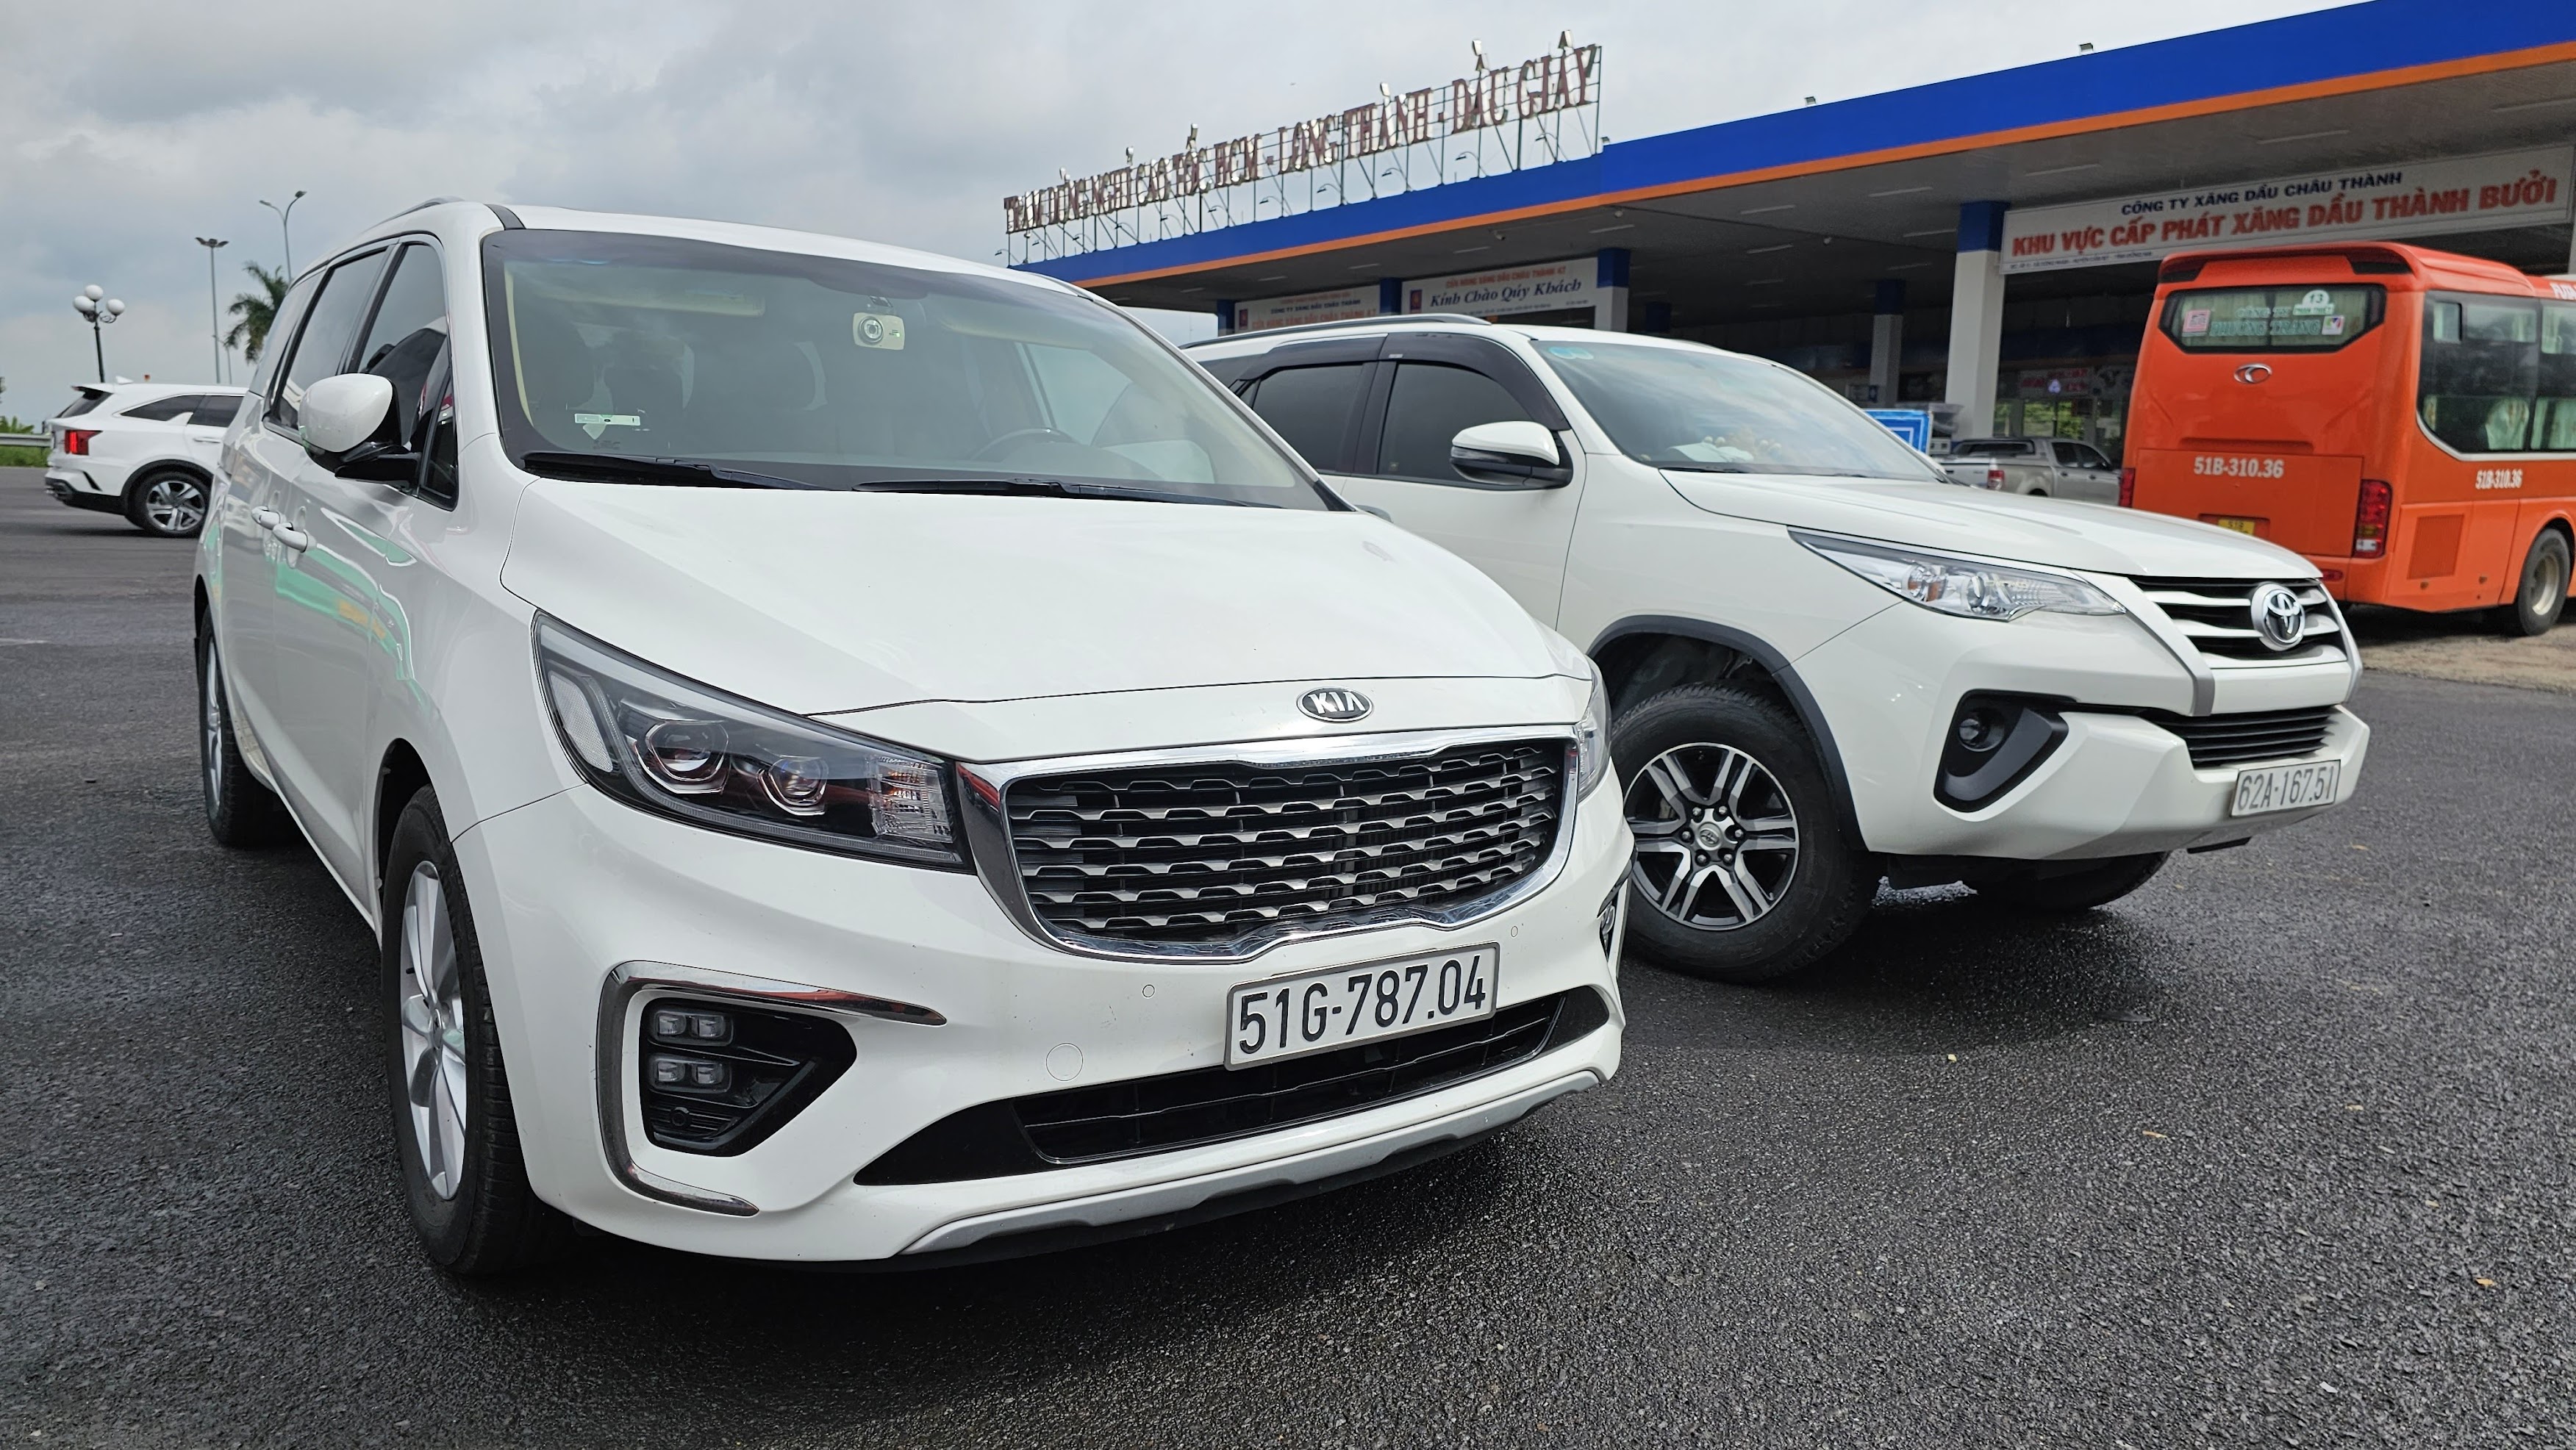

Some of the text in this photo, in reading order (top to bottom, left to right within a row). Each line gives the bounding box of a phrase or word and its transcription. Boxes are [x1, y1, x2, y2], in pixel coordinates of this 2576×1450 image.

[1214, 134, 1264, 189] HCM
[1278, 113, 1339, 175] LONG
[1342, 82, 1434, 159] THÀNH
[2011, 232, 2056, 256] KHU
[2061, 224, 2105, 256] VỰC
[2110, 215, 2157, 247] CẤP
[2161, 211, 2226, 242] PHÁT
[2231, 206, 2301, 235] XĂNG
[2372, 187, 2471, 220] THÀNH
[2477, 168, 2558, 210] BƯỞI
[2121, 201, 2164, 215] CÔNG
[2169, 197, 2189, 210] TY
[2283, 179, 2333, 198] CHÂU
[2339, 171, 2403, 191] THÀNH
[1429, 293, 1461, 307] Kính
[1464, 289, 1498, 304] Chào
[1534, 279, 1582, 298] Khách
[2194, 456, 2284, 478] 51B-310.36
[2475, 468, 2523, 490] 51B-310.36
[1308, 692, 1366, 714] KIA
[2238, 765, 2334, 811] 62A-167.51
[1239, 955, 1486, 1055] 51G-787.04
